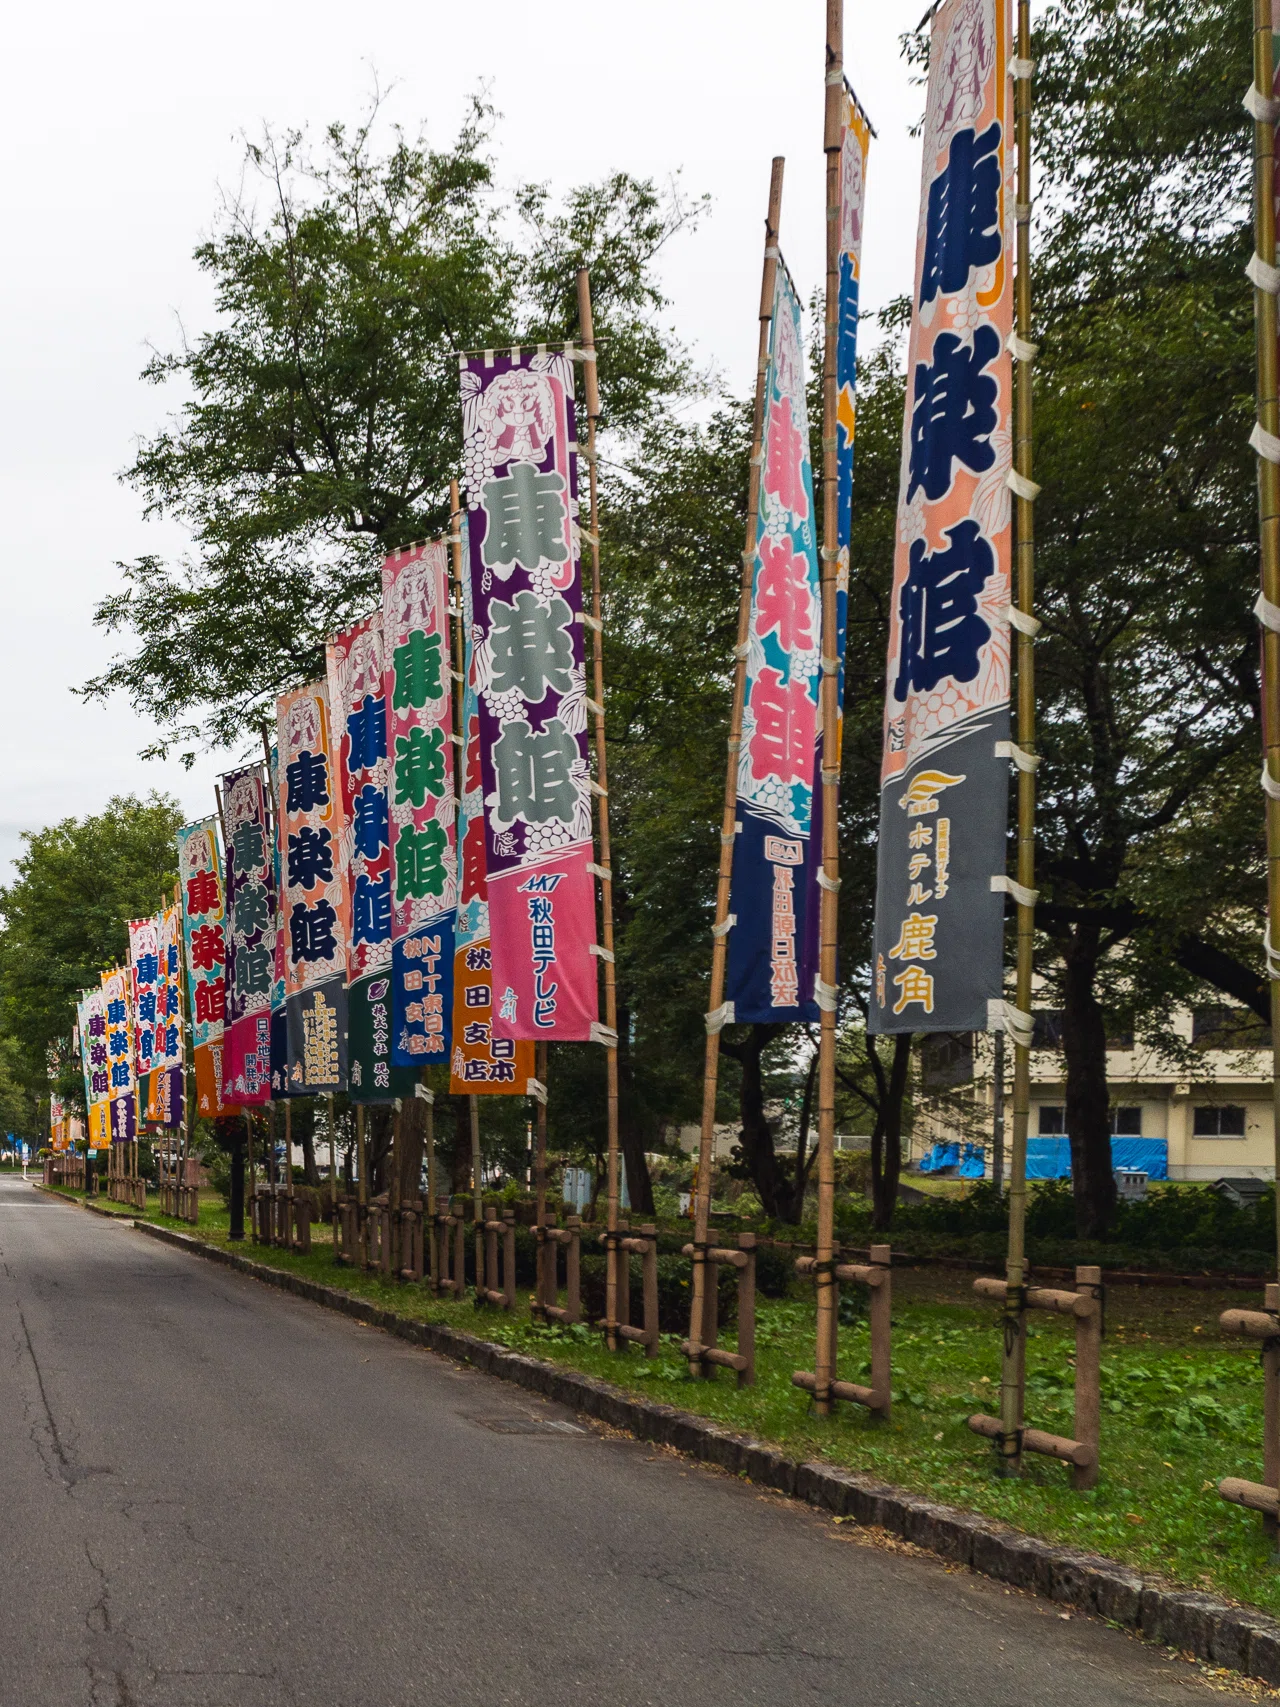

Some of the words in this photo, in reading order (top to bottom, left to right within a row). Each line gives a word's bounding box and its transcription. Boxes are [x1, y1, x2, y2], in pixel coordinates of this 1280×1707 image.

[893, 124, 1003, 702] 康楽館
[481, 463, 578, 826] 康楽館
[392, 629, 448, 904] 康楽館
[232, 821, 270, 997] 康楽館
[286, 751, 338, 963] 康楽館
[517, 874, 568, 892] AKT
[187, 870, 226, 1024] 康楽館
[528, 897, 557, 1028] 秋田テレビ
[889, 822, 938, 1015] ホテル鹿角
[108, 999, 130, 1087] 康楽館
[256, 1018, 270, 1084] 日本地下水
[372, 1003, 388, 1055] 株式会社
[403, 937, 425, 1055] 秋田支店
[421, 934, 446, 1053] NTT東日本
[463, 947, 492, 1082] 秋田支店
[89, 1014, 109, 1093] 康楽館
[156, 1072, 165, 1116] タテハナ
[374, 1062, 390, 1088] 現代
[490, 1037, 516, 1082] 日本
